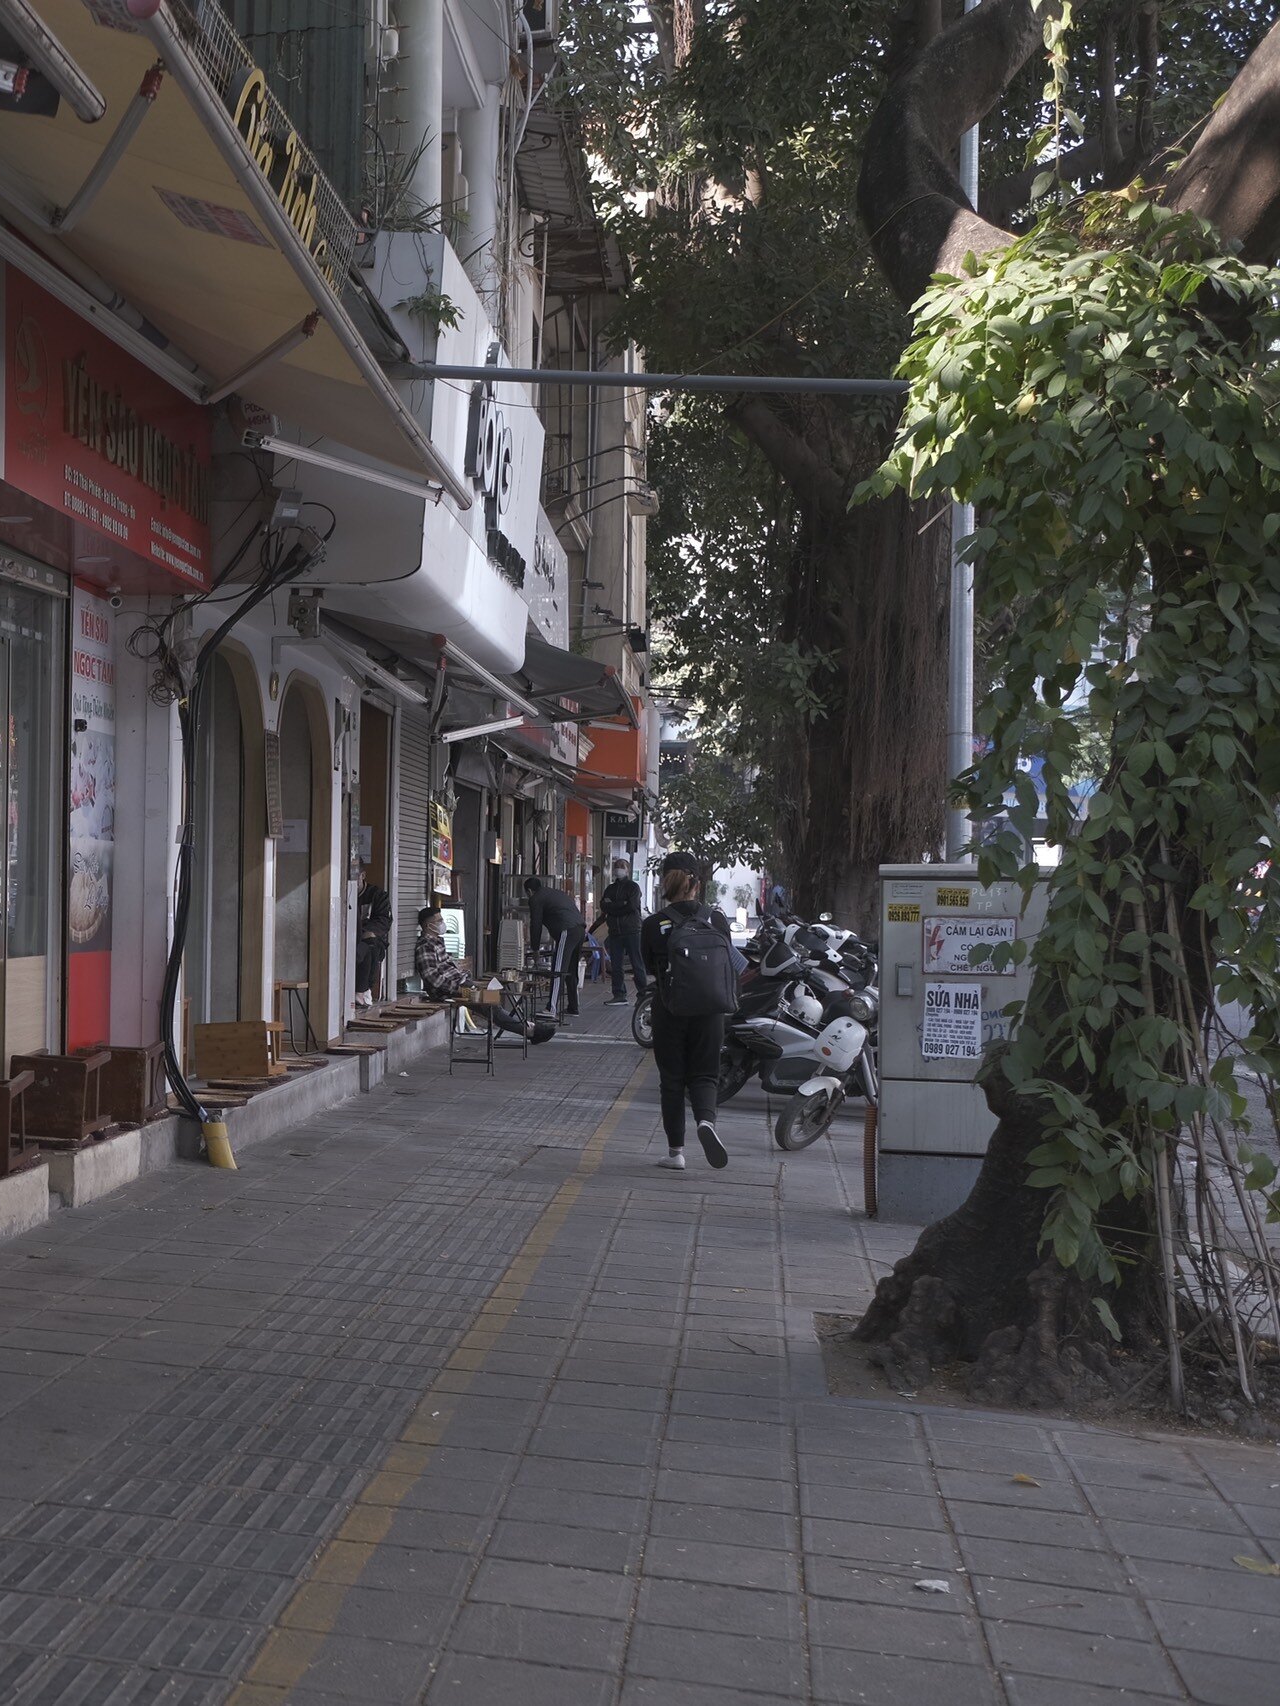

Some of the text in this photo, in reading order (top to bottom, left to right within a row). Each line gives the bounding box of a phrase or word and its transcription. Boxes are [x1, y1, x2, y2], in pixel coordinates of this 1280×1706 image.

[80, 605, 94, 641] YẾN
[74, 650, 96, 685] NGỌC
[926, 985, 979, 1010] SỬA NHÀ
[924, 1043, 976, 1057] 0989 027 194
